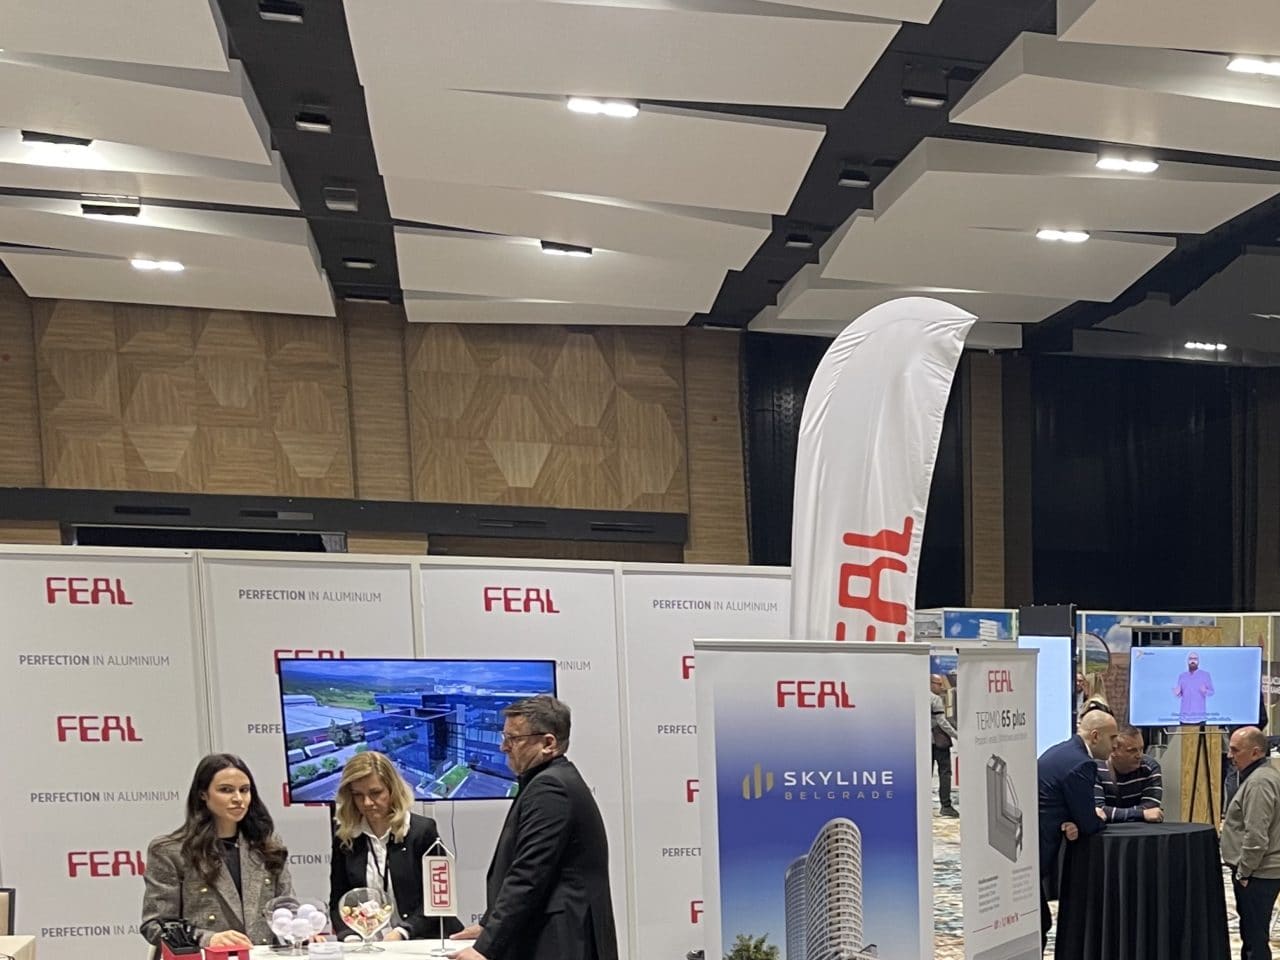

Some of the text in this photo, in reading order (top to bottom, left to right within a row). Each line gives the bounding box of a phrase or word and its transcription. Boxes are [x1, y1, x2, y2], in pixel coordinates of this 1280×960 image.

[46, 577, 133, 605] FEAL
[238, 589, 382, 602] PERFECTION IN ALUMINIUM
[483, 586, 560, 613] FEAL
[652, 600, 778, 612] PERFECTION IN ALUMINIUM
[19, 655, 170, 667] PERFECTION IN ALUMINIUM
[987, 670, 1014, 693] FEAL
[776, 680, 856, 708] FEAL
[57, 715, 143, 742] FEAL
[1001, 709, 1011, 728] 65
[1013, 709, 1026, 730] plus
[784, 770, 894, 786] SKYLINE
[30, 790, 180, 803] PERFECTION IN ALUMINIUM
[784, 790, 894, 800] BELGRADE
[431, 861, 449, 907] FEAL
[41, 926, 111, 938] PERFECTION
[113, 925, 126, 936] IN
